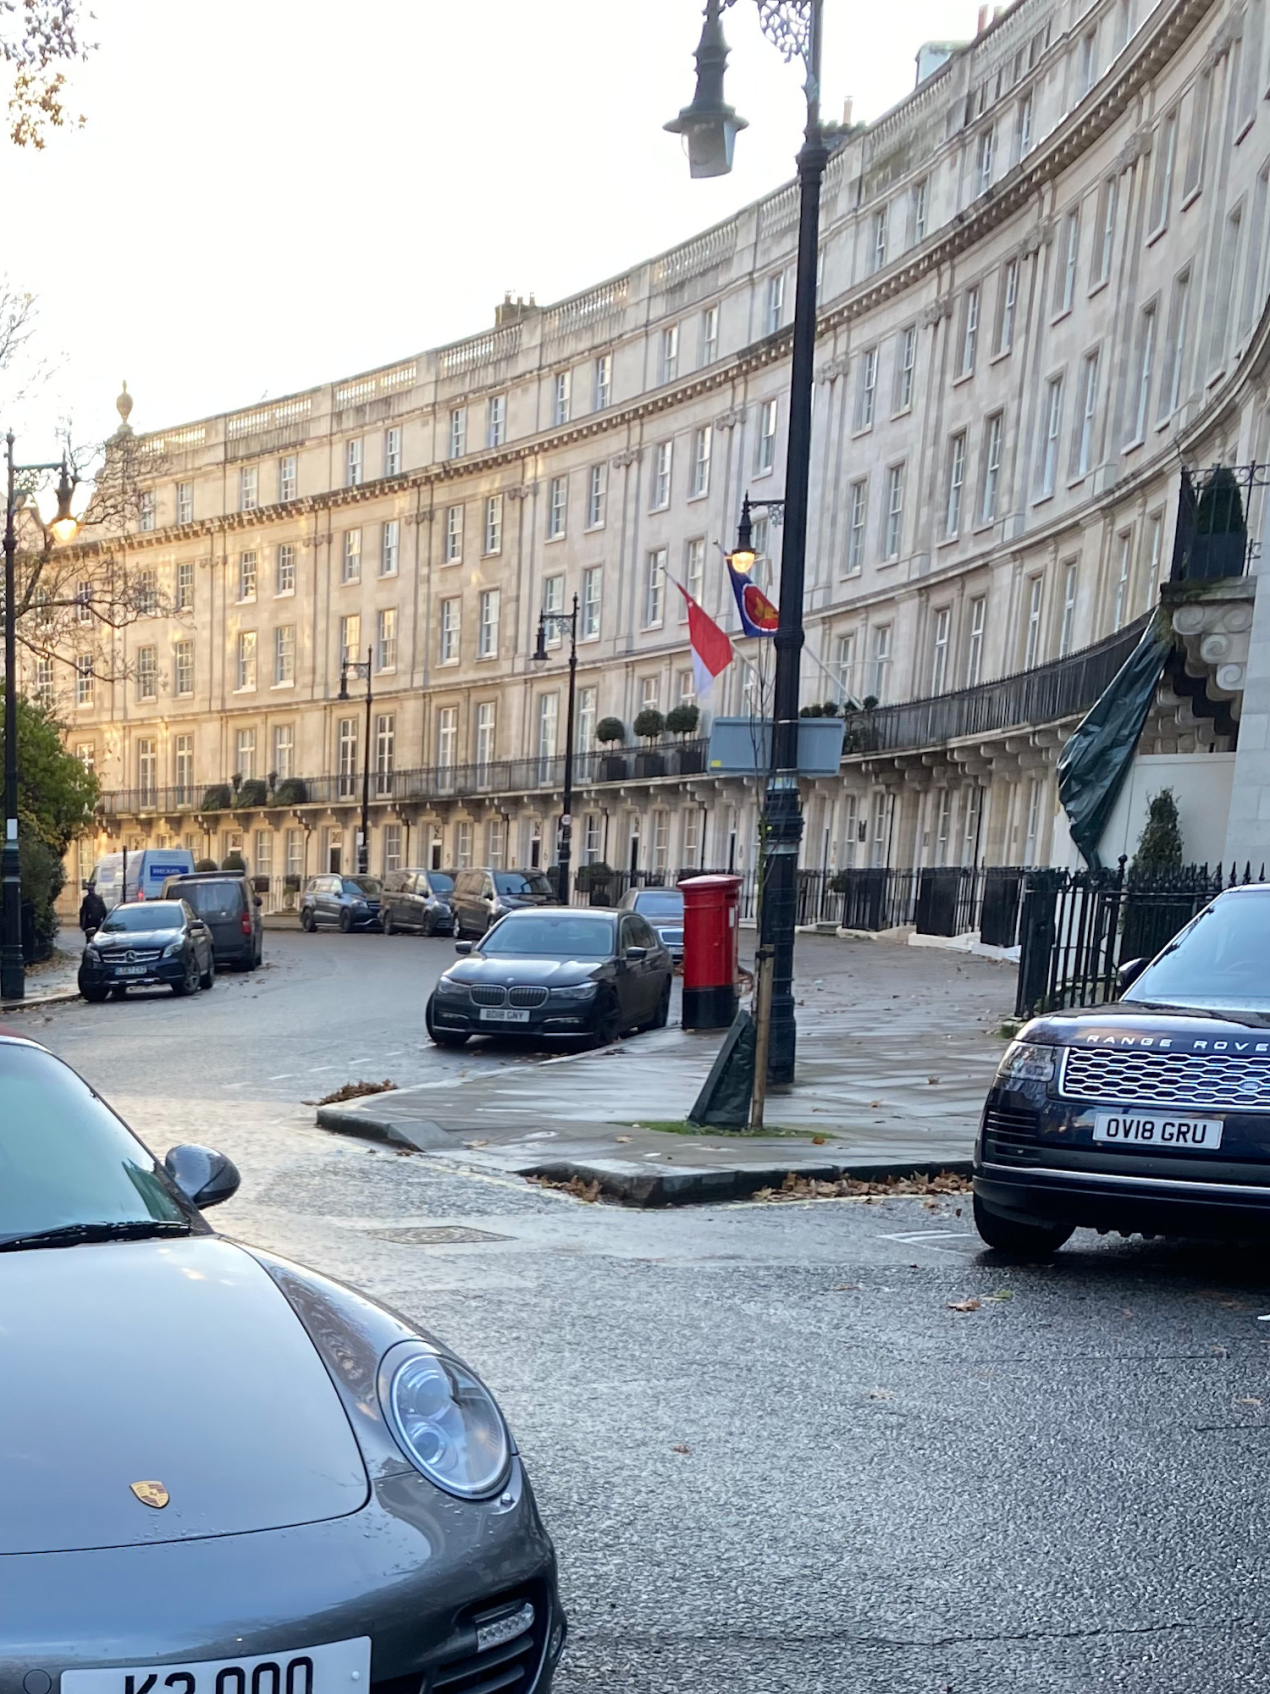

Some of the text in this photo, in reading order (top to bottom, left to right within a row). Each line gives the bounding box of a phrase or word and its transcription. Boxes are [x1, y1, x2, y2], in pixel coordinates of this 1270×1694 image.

[1087, 1035, 1172, 1047] RANGE
[1106, 1118, 1207, 1144] OV18 GRU
